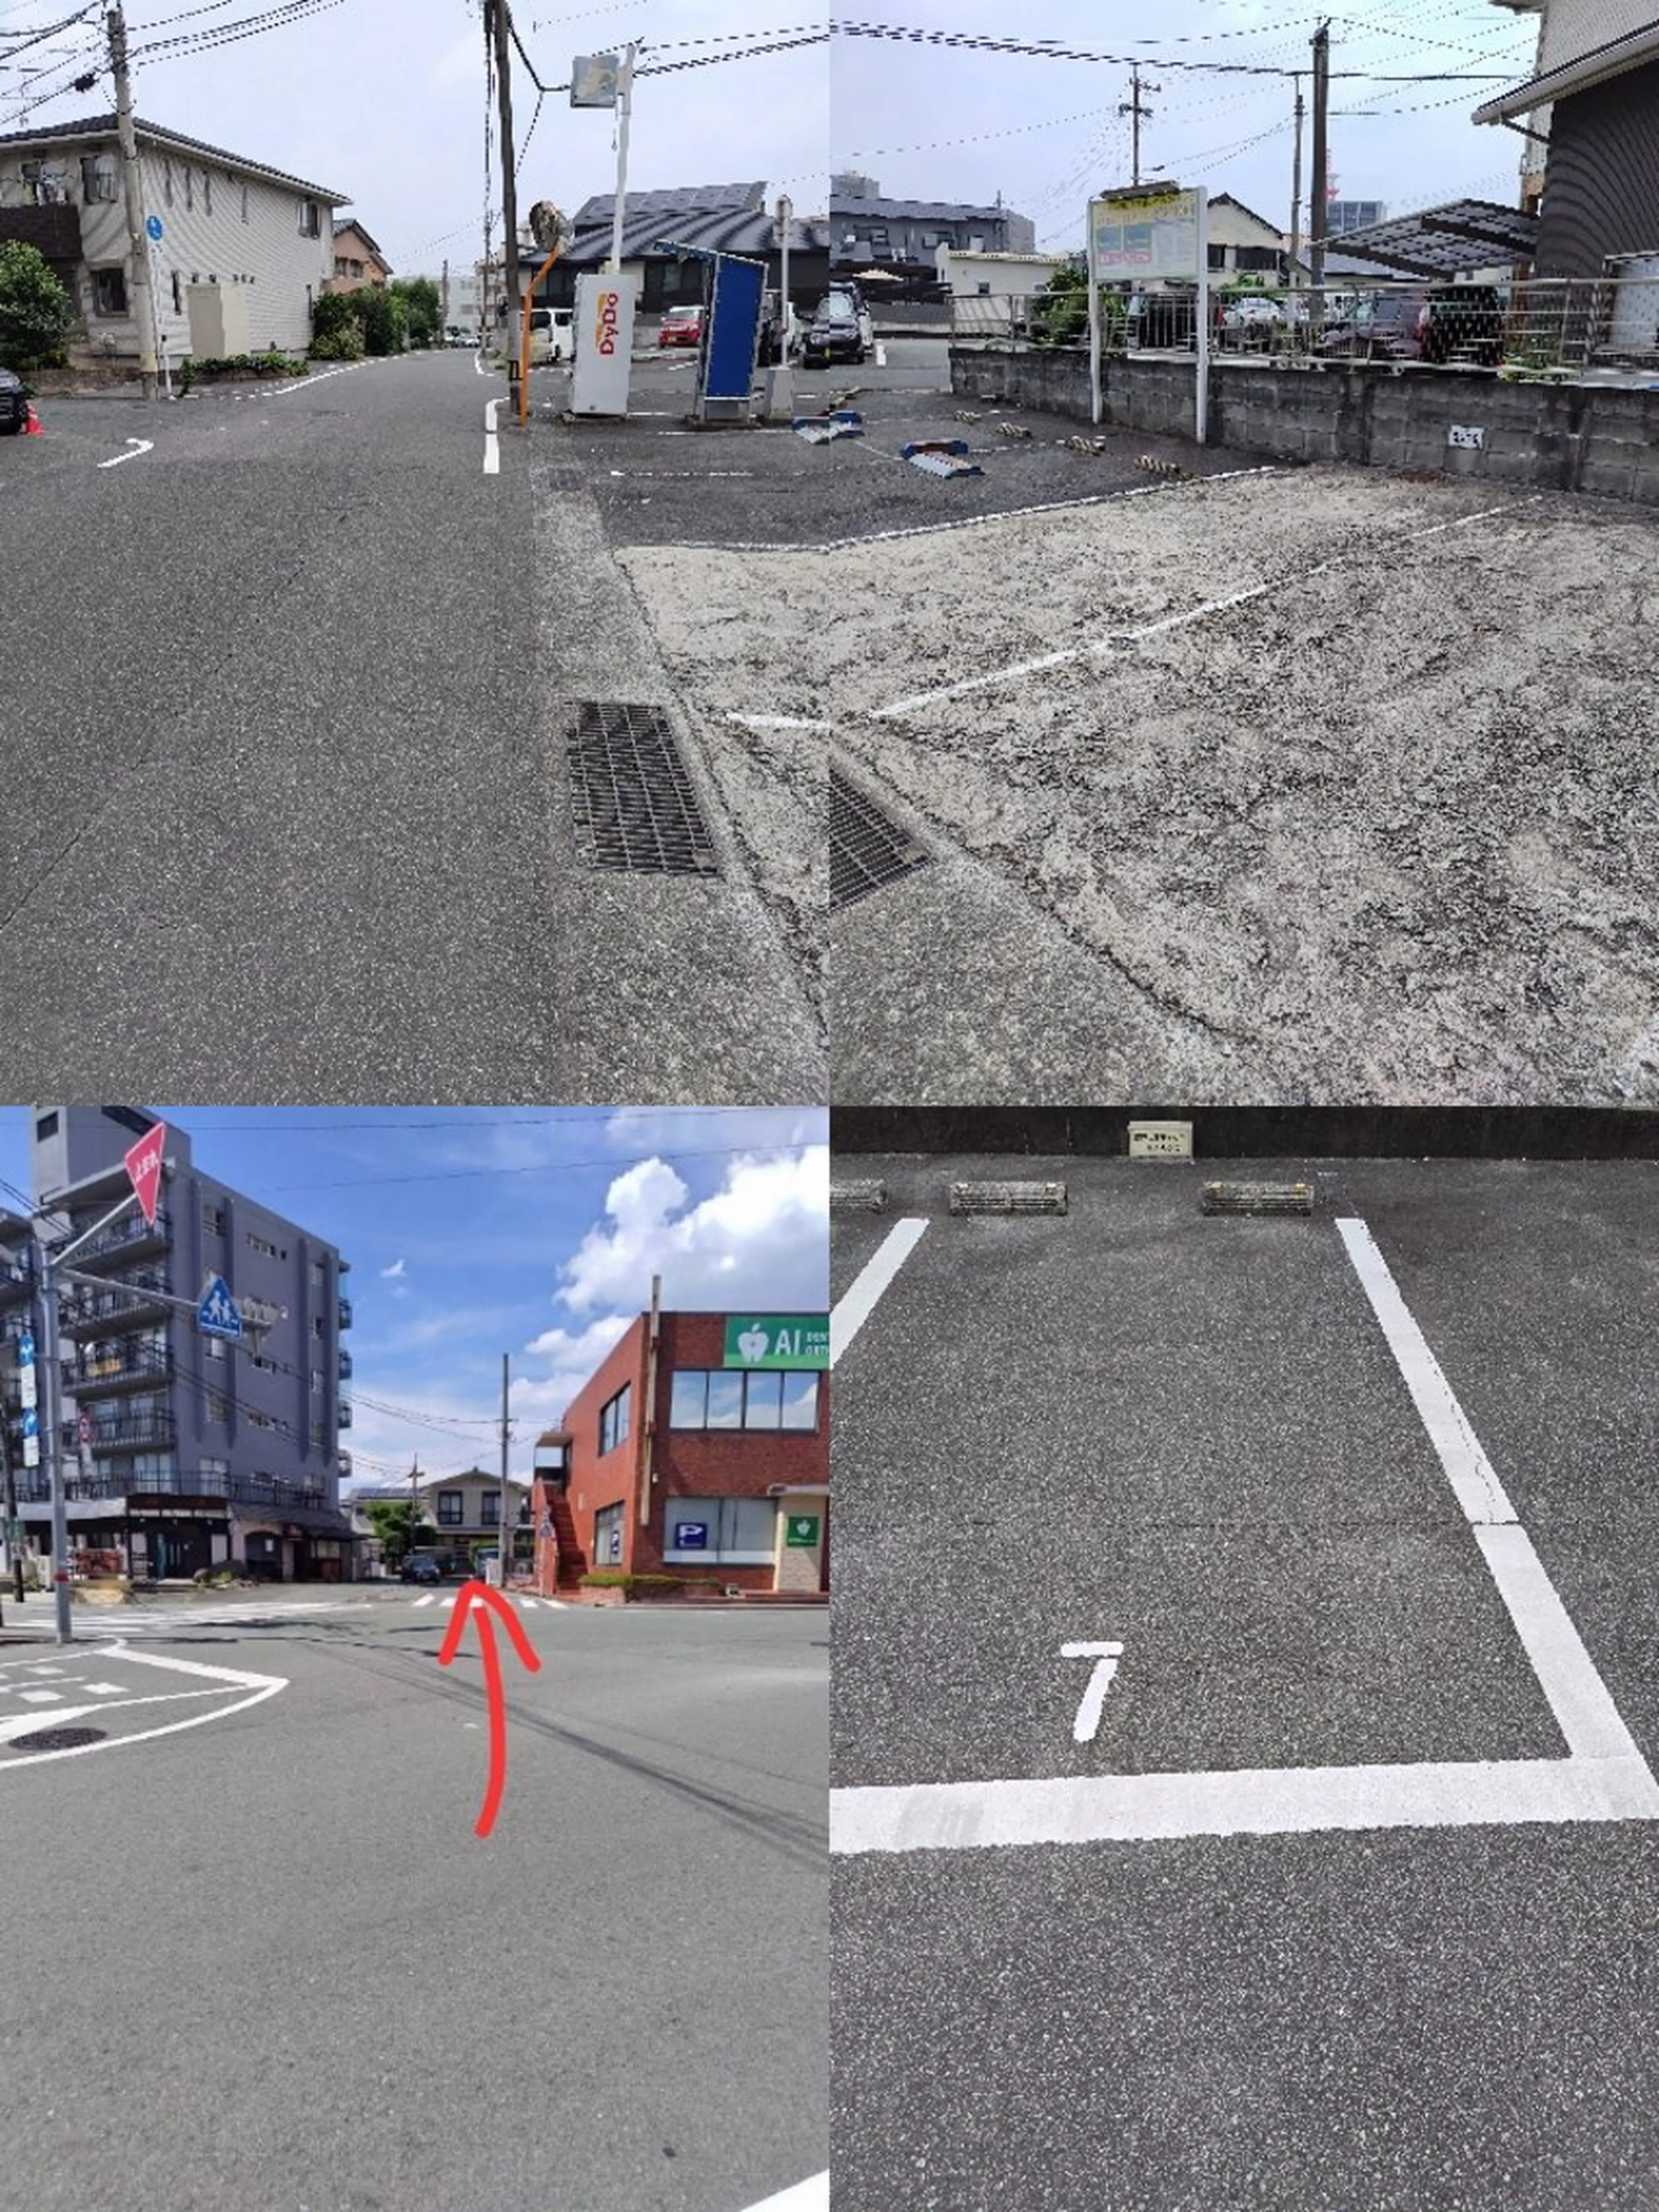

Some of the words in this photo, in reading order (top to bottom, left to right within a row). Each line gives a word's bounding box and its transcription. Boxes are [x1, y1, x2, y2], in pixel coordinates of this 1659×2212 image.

[599, 292, 619, 355] DyDo
[774, 1329, 801, 1356] AI
[1061, 1641, 1124, 1742] 7
